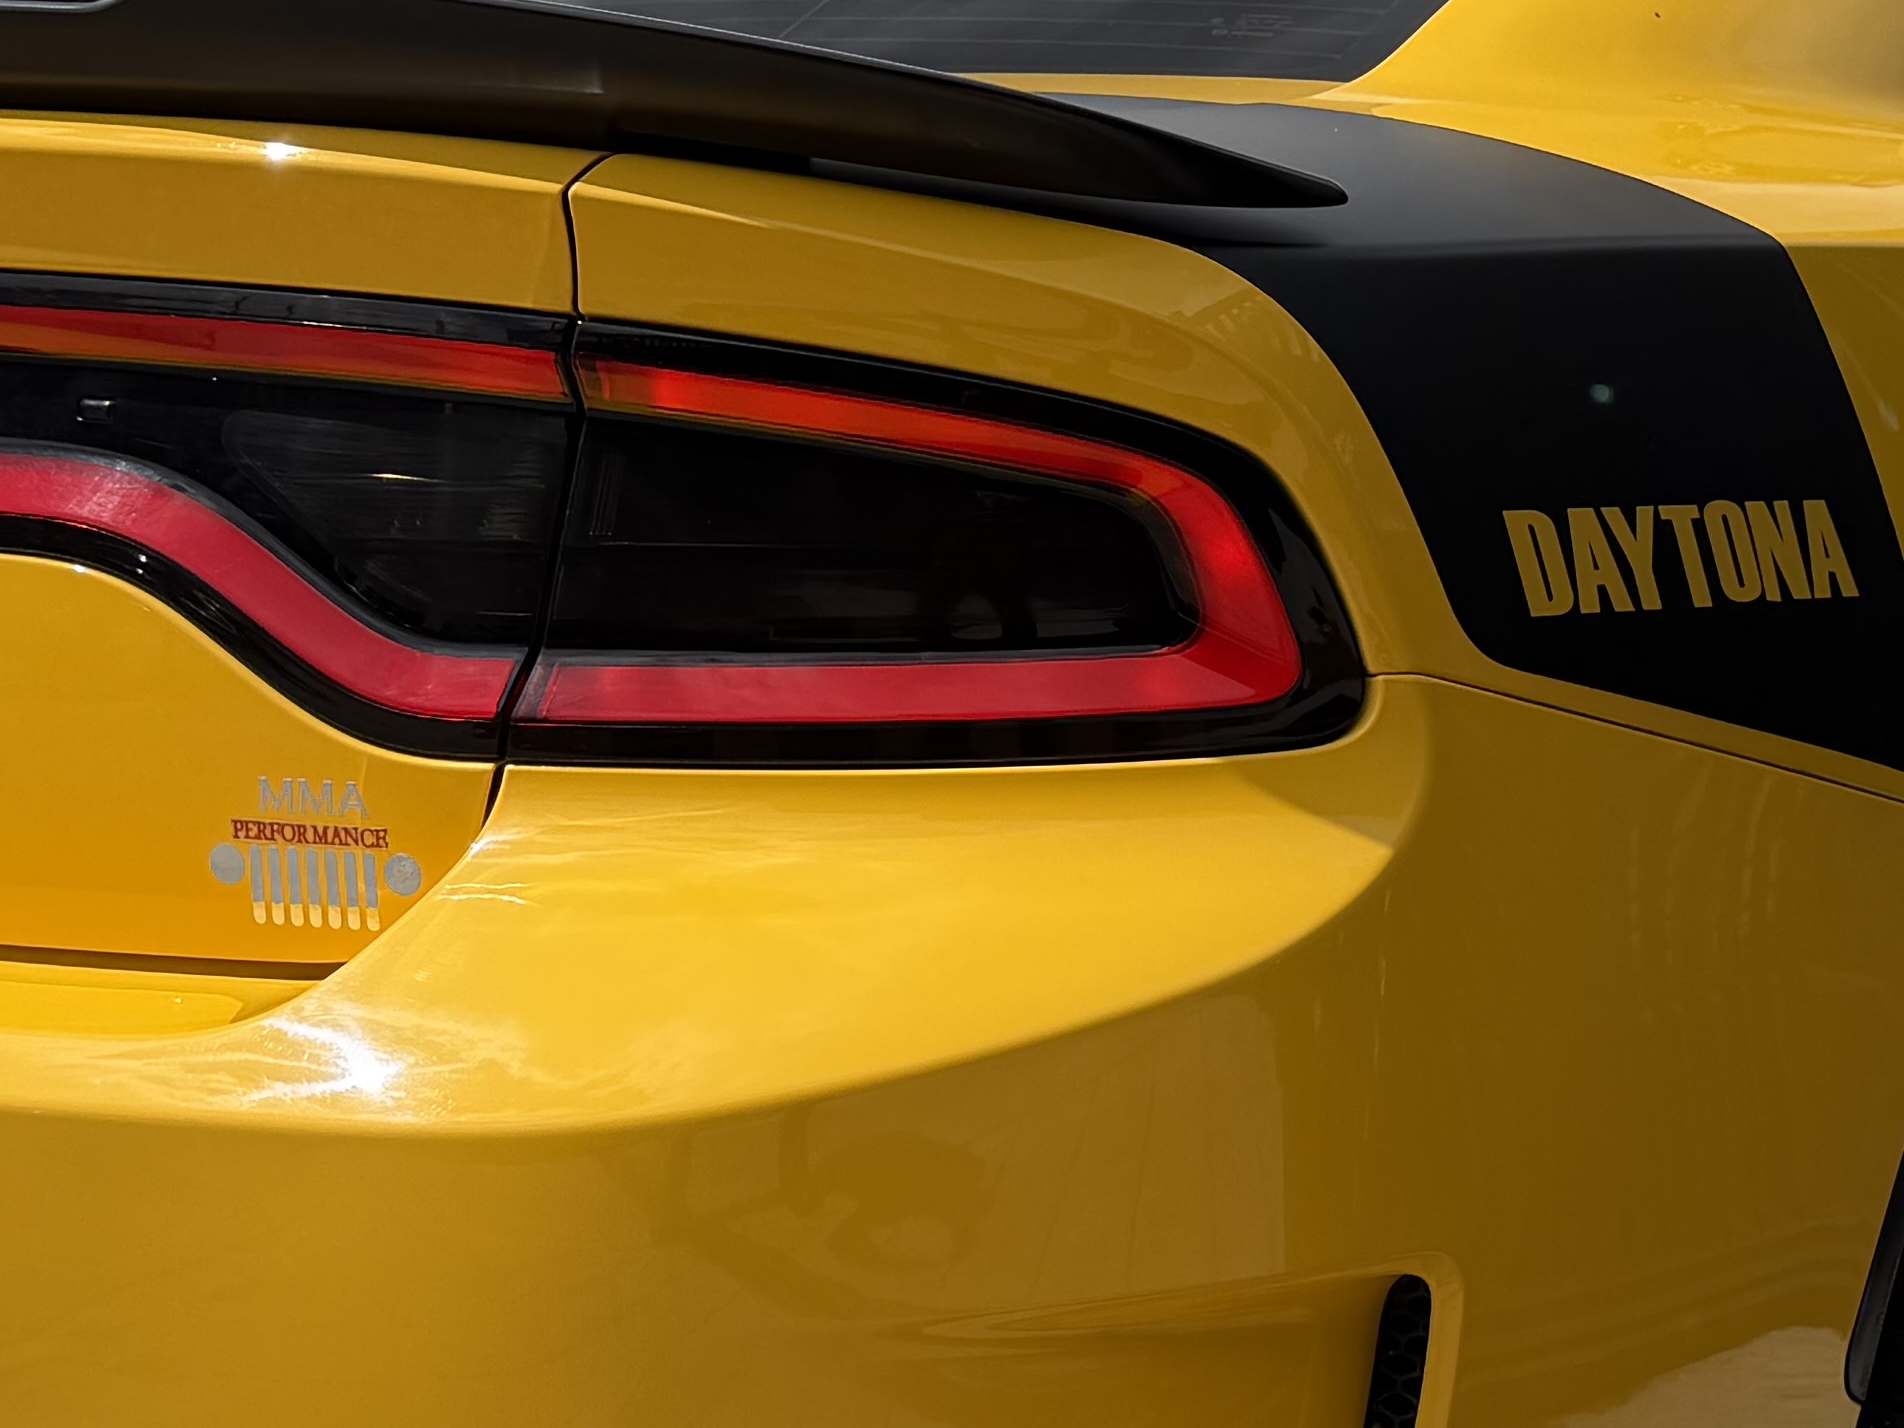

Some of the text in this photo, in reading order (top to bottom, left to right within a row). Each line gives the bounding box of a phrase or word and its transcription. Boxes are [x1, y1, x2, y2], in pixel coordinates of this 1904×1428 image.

[1502, 499, 1860, 618] DAYTONA
[257, 775, 368, 819] MMA
[231, 818, 389, 849] PERFORMANCE
